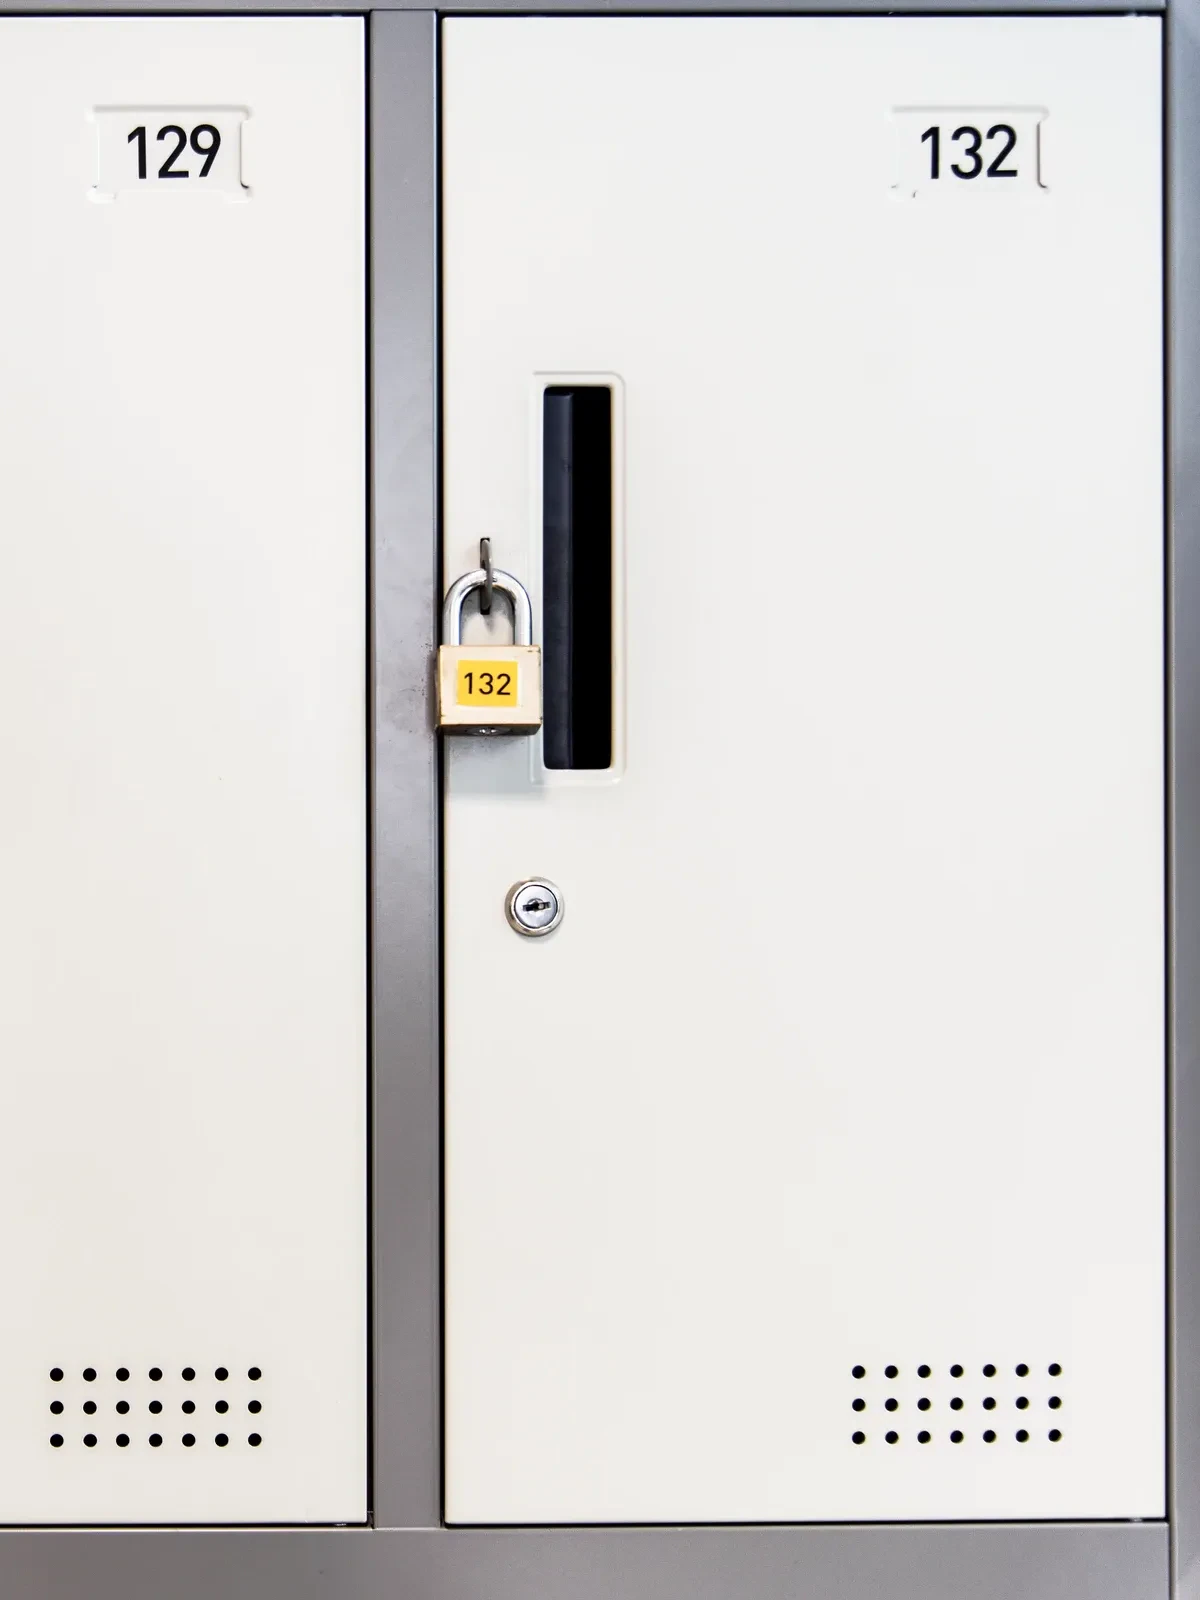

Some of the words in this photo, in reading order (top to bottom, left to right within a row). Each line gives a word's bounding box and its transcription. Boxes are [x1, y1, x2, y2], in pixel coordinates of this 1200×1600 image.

[127, 124, 221, 179] 129
[921, 124, 1018, 180] 132
[464, 672, 511, 696] 132
